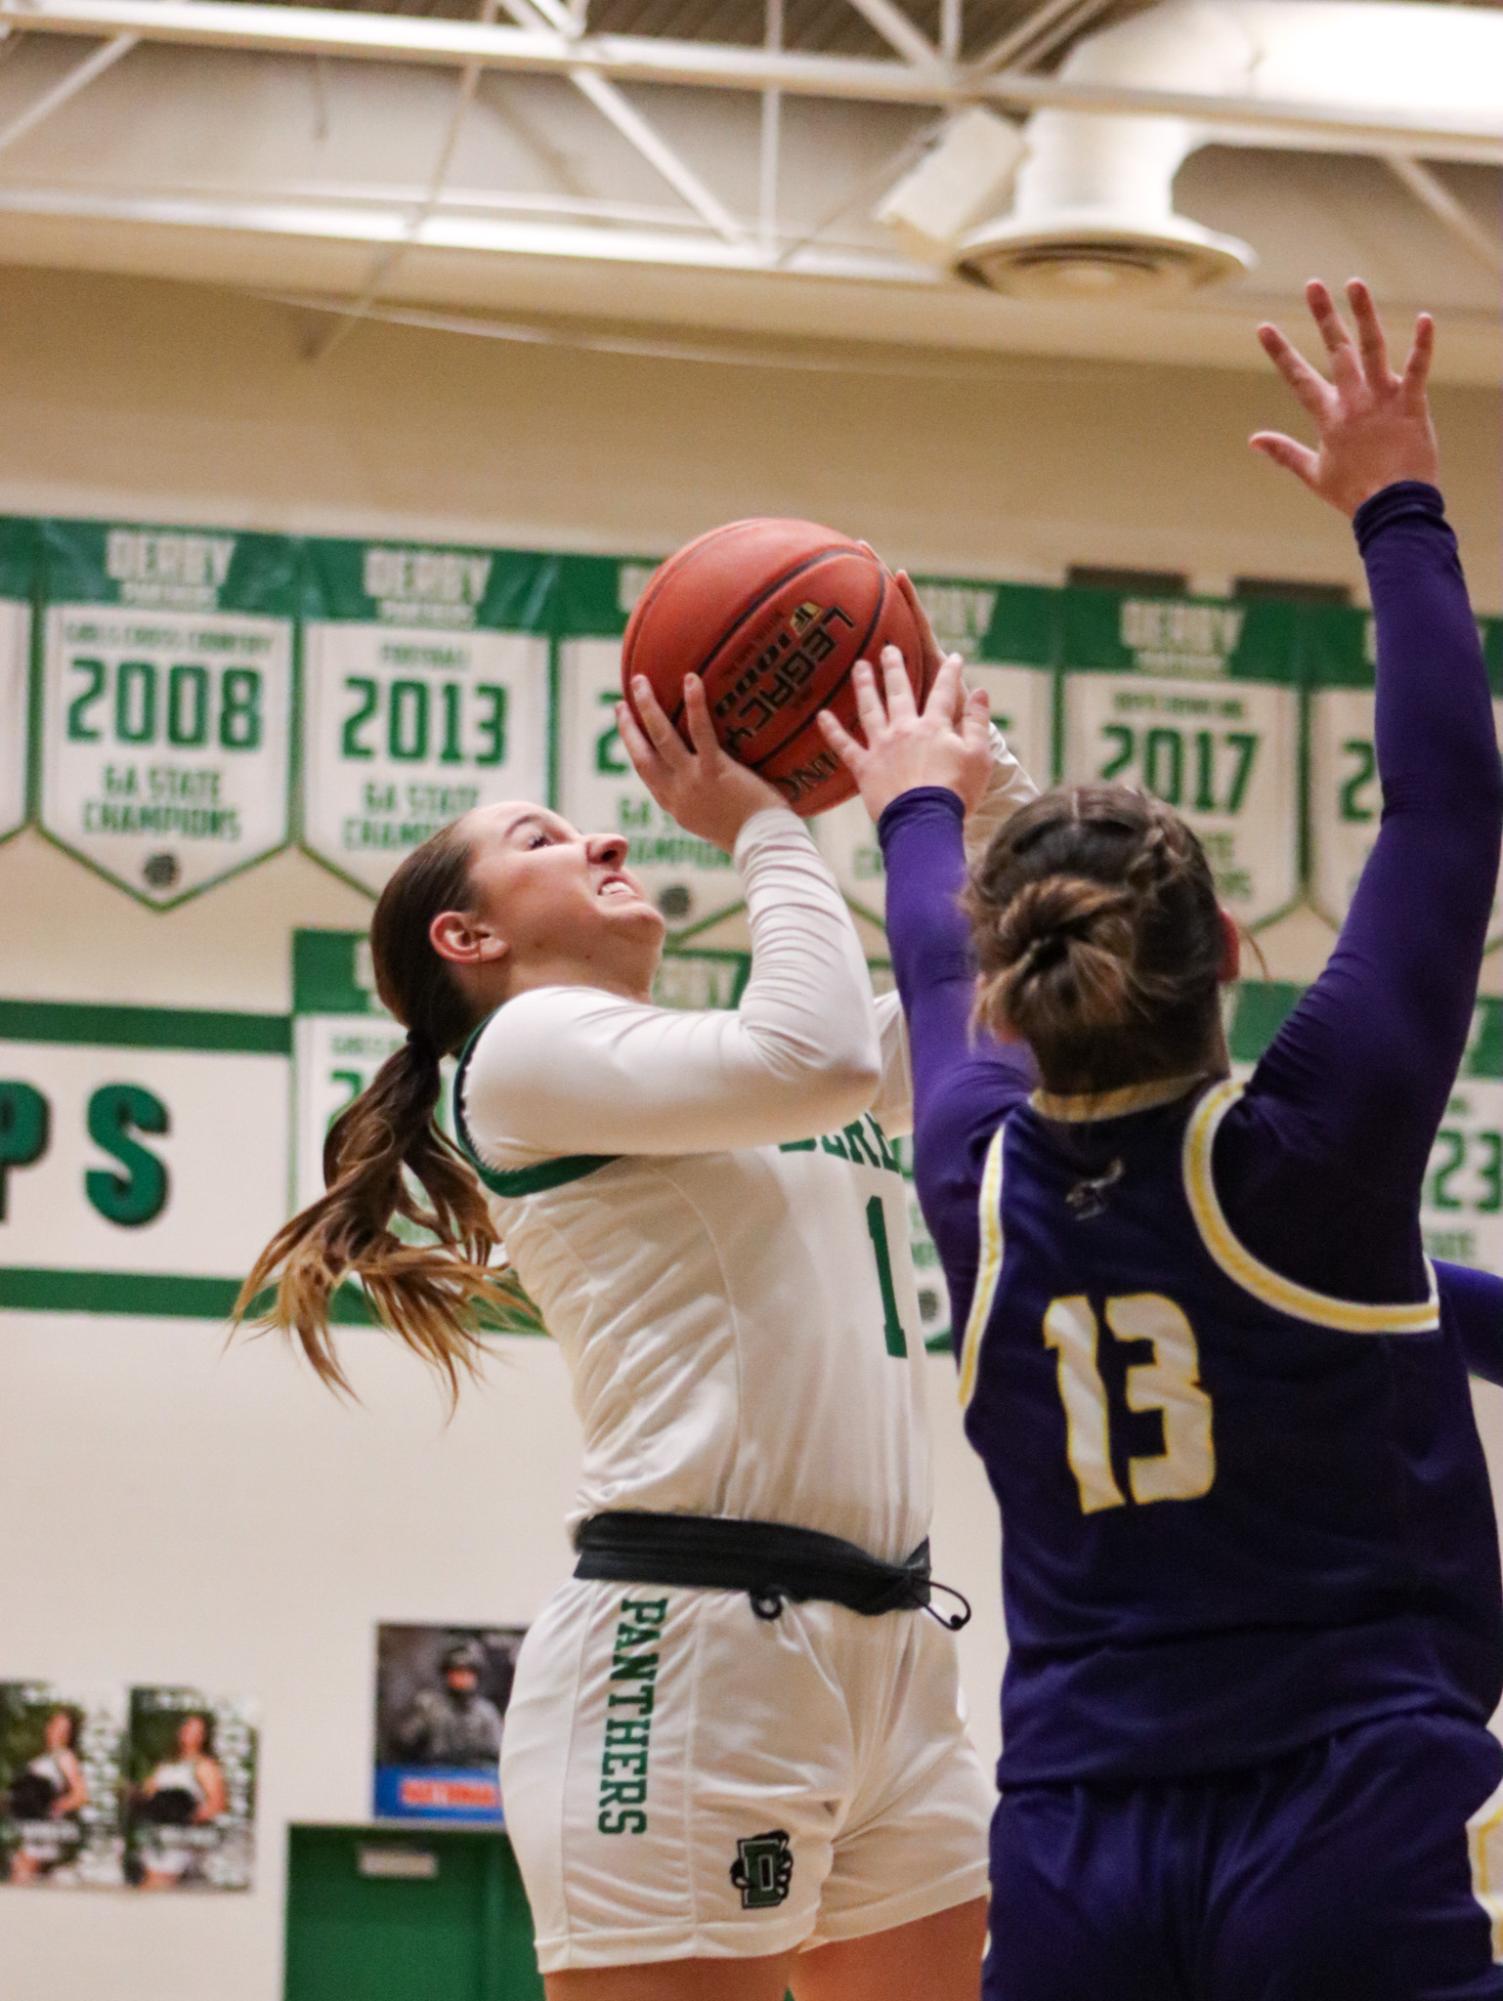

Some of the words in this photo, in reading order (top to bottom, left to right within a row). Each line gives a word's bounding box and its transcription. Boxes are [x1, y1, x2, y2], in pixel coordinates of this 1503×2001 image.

[67, 658, 263, 751] 2008
[341, 676, 508, 767] 2013
[723, 605, 856, 754] LEGACY
[147, 767, 222, 801] STATE
[1101, 724, 1259, 814] 2017
[83, 802, 242, 840] CHAMPIONS
[1043, 1292, 1217, 1516] 13
[598, 1597, 669, 1835] PANTHERS
